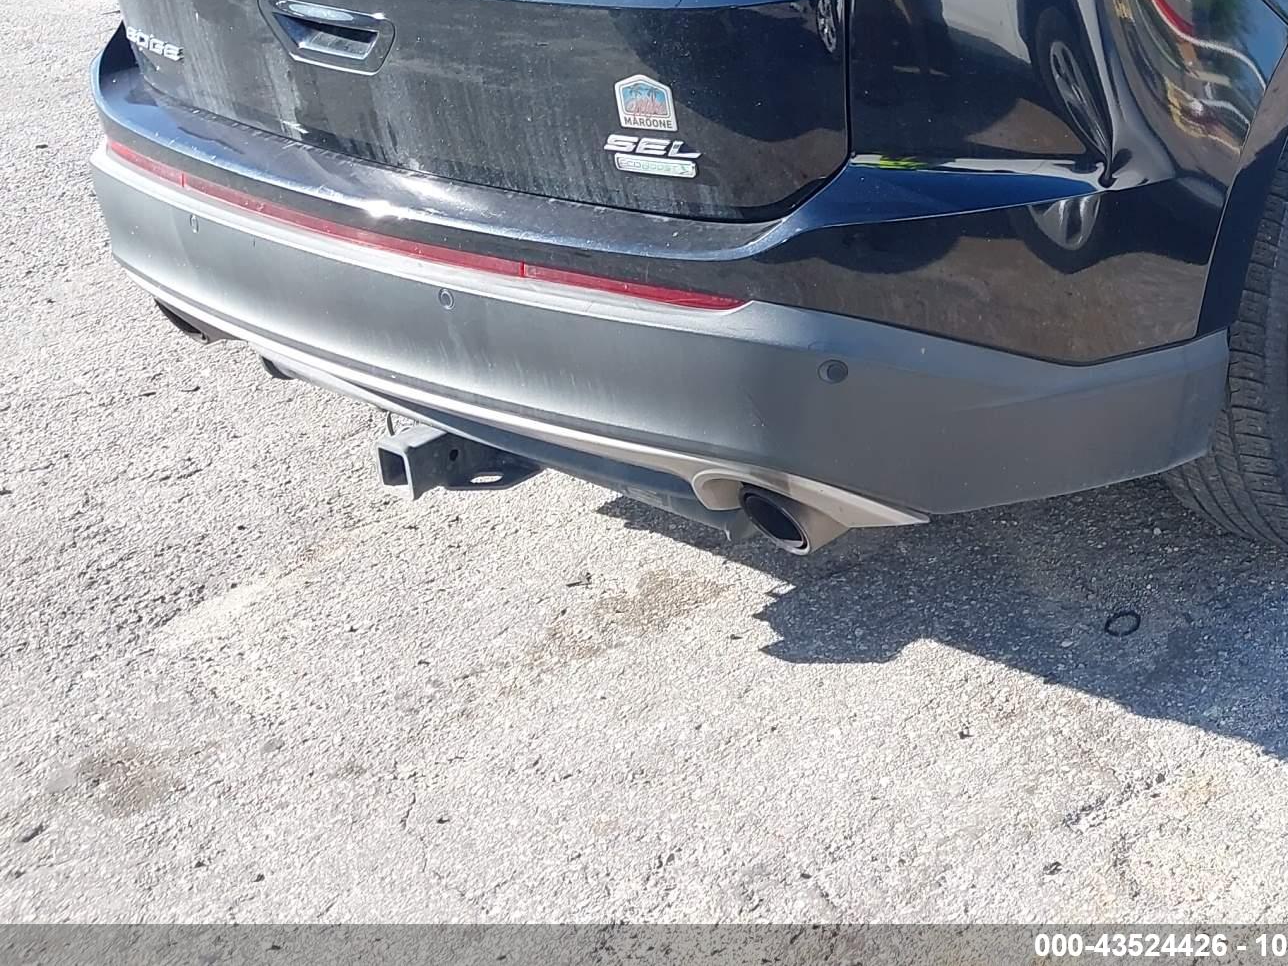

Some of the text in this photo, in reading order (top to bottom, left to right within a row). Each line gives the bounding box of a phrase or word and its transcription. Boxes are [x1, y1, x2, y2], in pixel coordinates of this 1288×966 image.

[126, 26, 184, 62] EDGE
[623, 116, 673, 129] MAROONE
[603, 134, 702, 159] SEL
